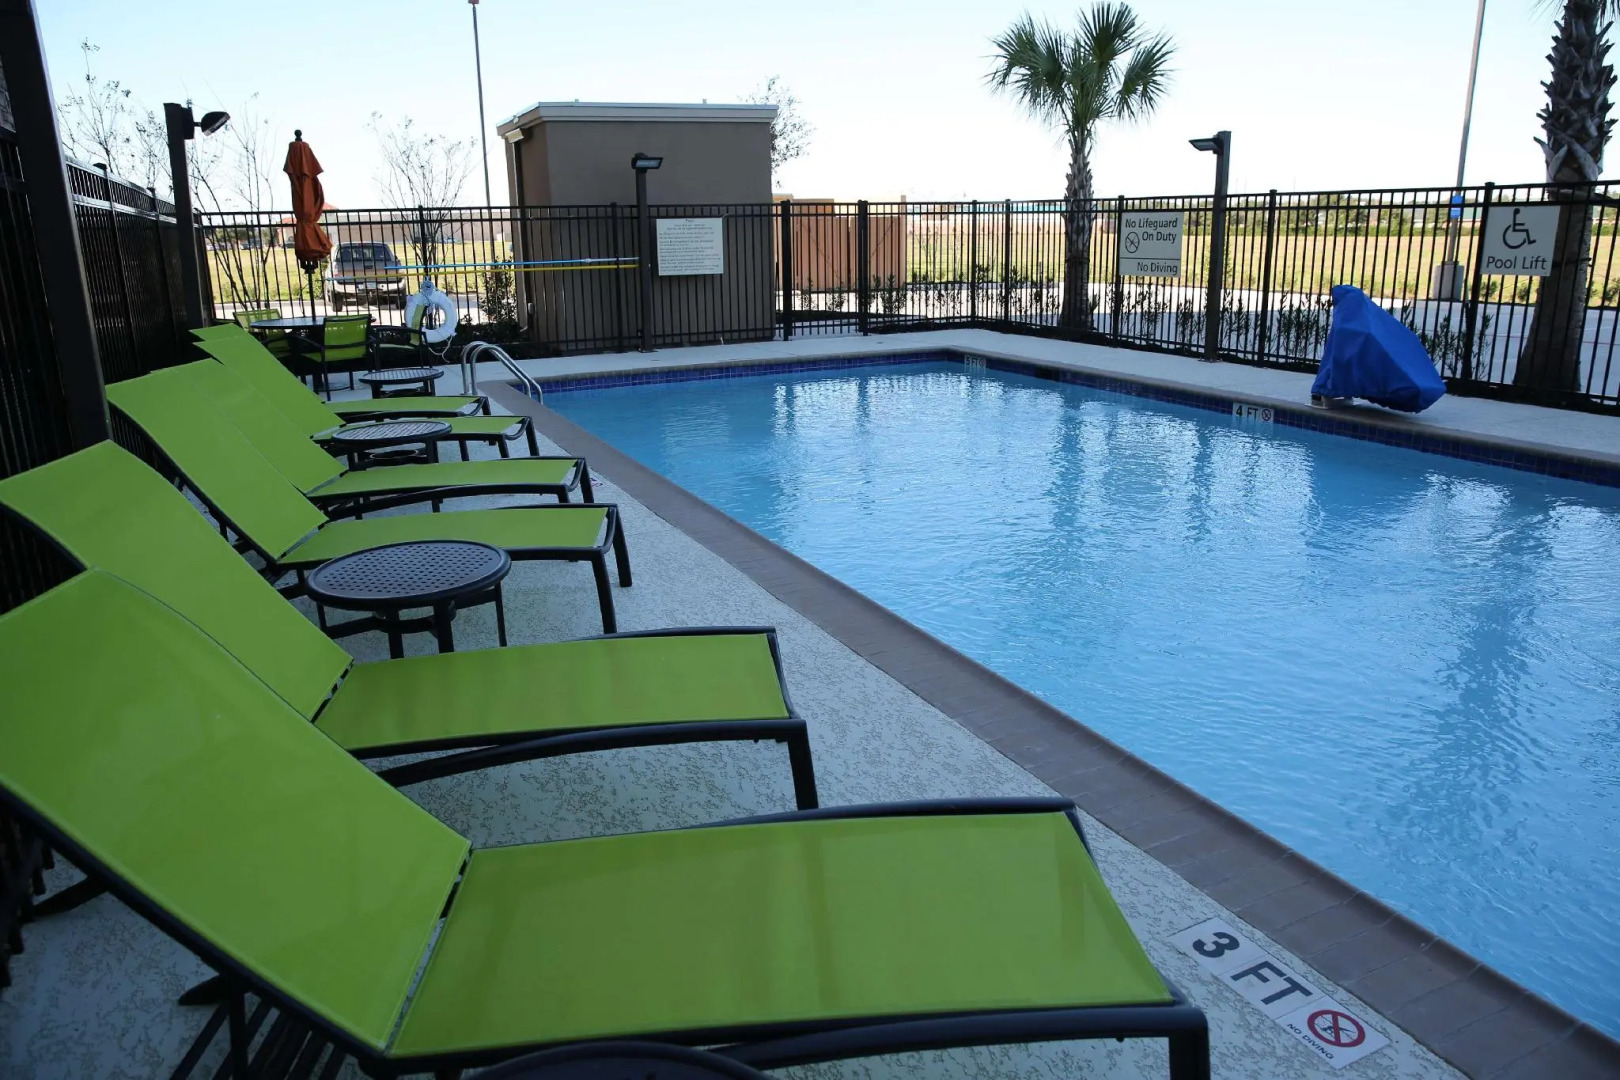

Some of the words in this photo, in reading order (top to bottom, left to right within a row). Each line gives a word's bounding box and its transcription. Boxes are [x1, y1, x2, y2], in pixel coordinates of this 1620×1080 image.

[1125, 218, 1136, 229] No
[1138, 217, 1178, 231] Lifeguard
[1141, 231, 1154, 241] On
[1156, 231, 1177, 244] Duty
[1136, 262, 1149, 272] No
[1150, 262, 1178, 276] Diving
[1486, 255, 1517, 270] Pool
[1522, 255, 1547, 270] Lift
[1236, 405, 1243, 417] 4
[1247, 407, 1259, 420] FT
[1192, 931, 1240, 958] 3
[1230, 960, 1313, 1005] FT
[1286, 1023, 1302, 1035] NO
[1302, 1034, 1335, 1060] DIVING
